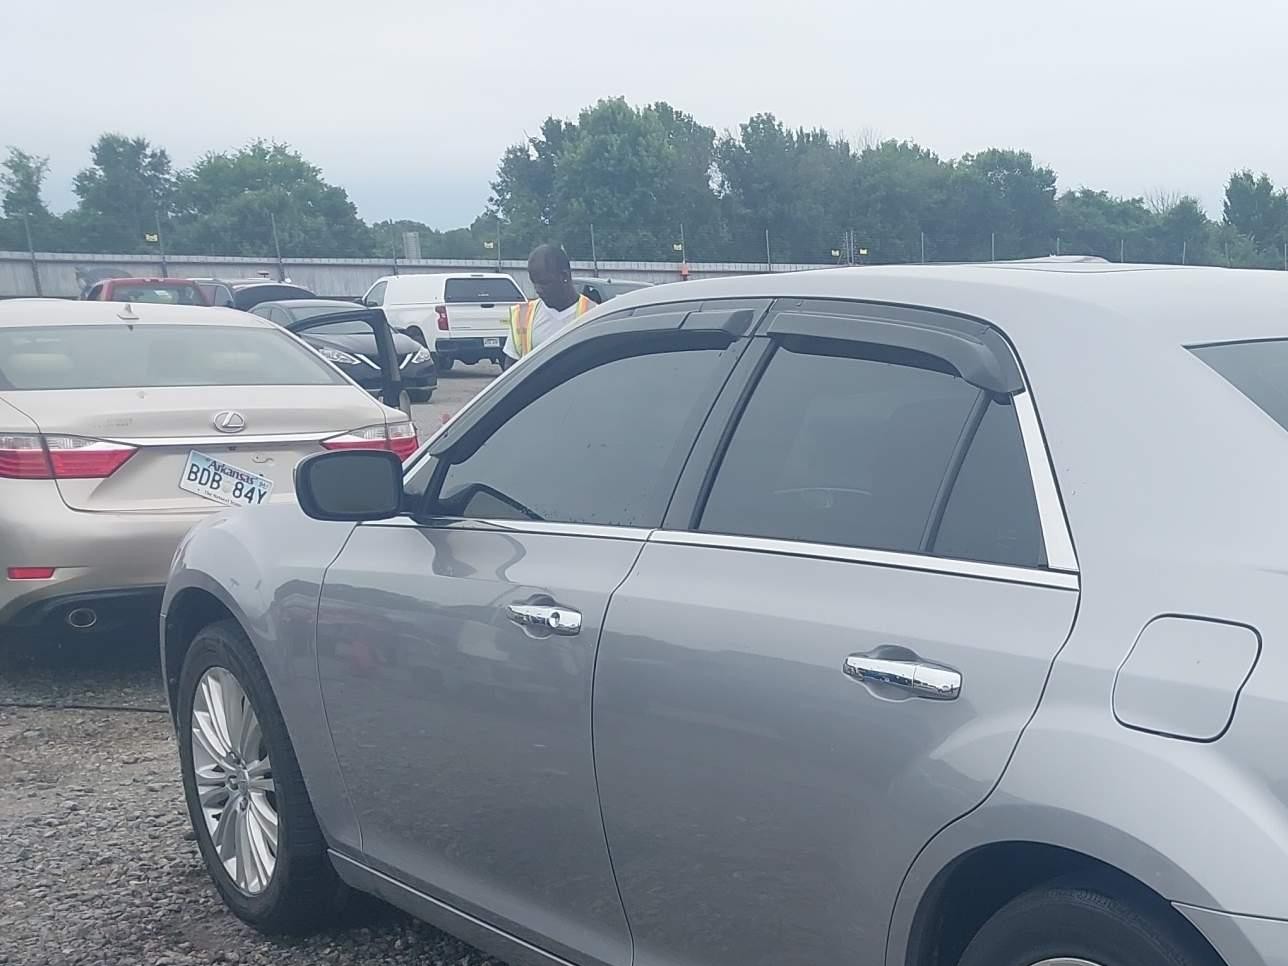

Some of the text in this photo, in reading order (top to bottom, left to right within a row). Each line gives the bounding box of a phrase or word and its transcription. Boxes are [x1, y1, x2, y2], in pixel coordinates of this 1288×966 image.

[187, 463, 267, 505] BDB 84Y
[208, 460, 255, 485] Arkansas
